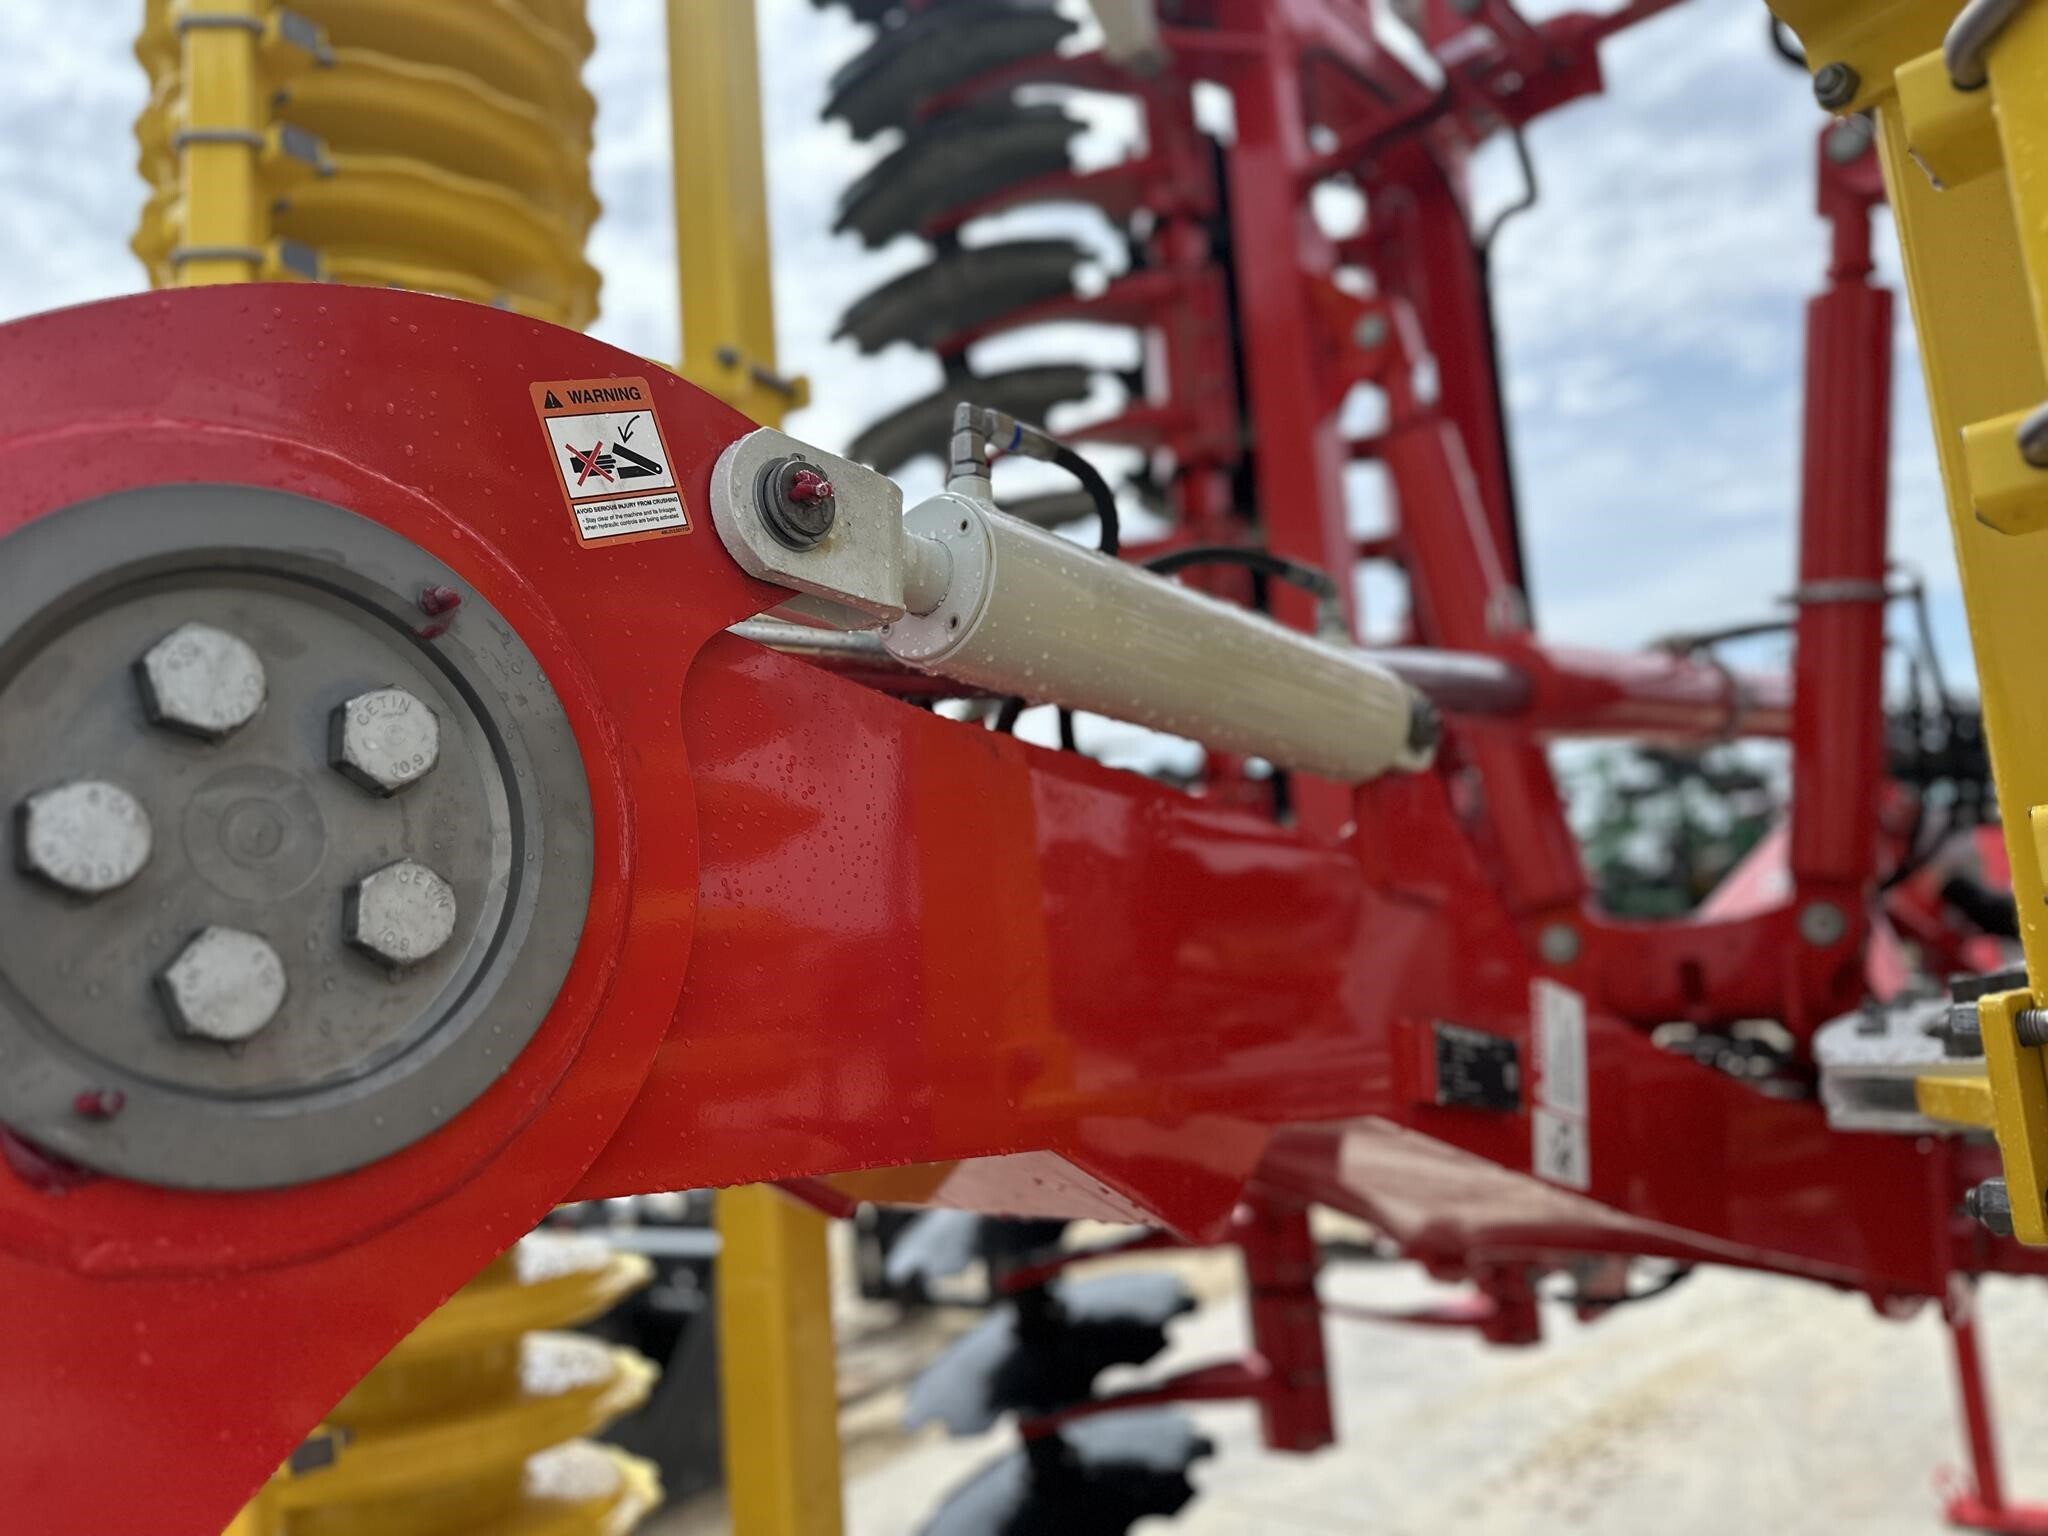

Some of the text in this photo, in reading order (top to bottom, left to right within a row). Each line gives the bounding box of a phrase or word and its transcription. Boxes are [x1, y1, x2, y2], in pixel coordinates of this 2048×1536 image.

[566, 386, 641, 404] WARNING
[576, 496, 678, 515] AVOID SERIOUS INJURY FROM CRUSHING
[584, 523, 598, 531] when
[598, 520, 620, 530] hydraulic
[620, 518, 638, 527] controls
[646, 515, 660, 524] being
[659, 513, 679, 522] activated
[585, 517, 597, 525] Stay
[597, 514, 609, 522] clear
[609, 513, 615, 521] of
[623, 510, 643, 519] machine
[658, 506, 677, 515] linkages
[356, 694, 411, 726] CETIN
[391, 752, 424, 777] 10.9
[398, 870, 449, 908] CETIN
